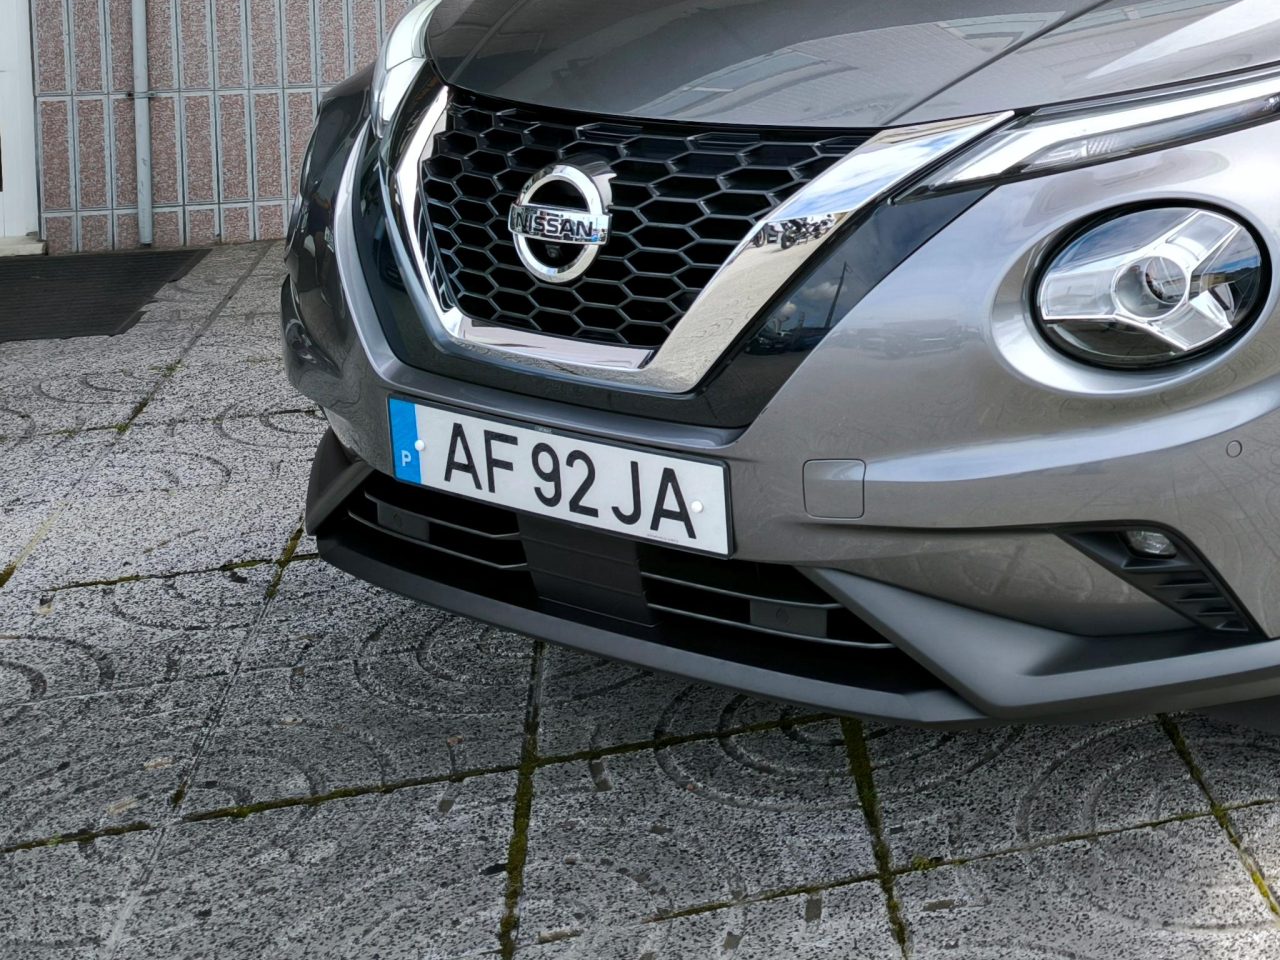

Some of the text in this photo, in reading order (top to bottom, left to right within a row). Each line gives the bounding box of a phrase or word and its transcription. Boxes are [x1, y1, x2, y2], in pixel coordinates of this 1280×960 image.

[516, 211, 593, 238] NISSAN
[401, 450, 412, 467] P
[444, 423, 697, 539] AF 92 JA
